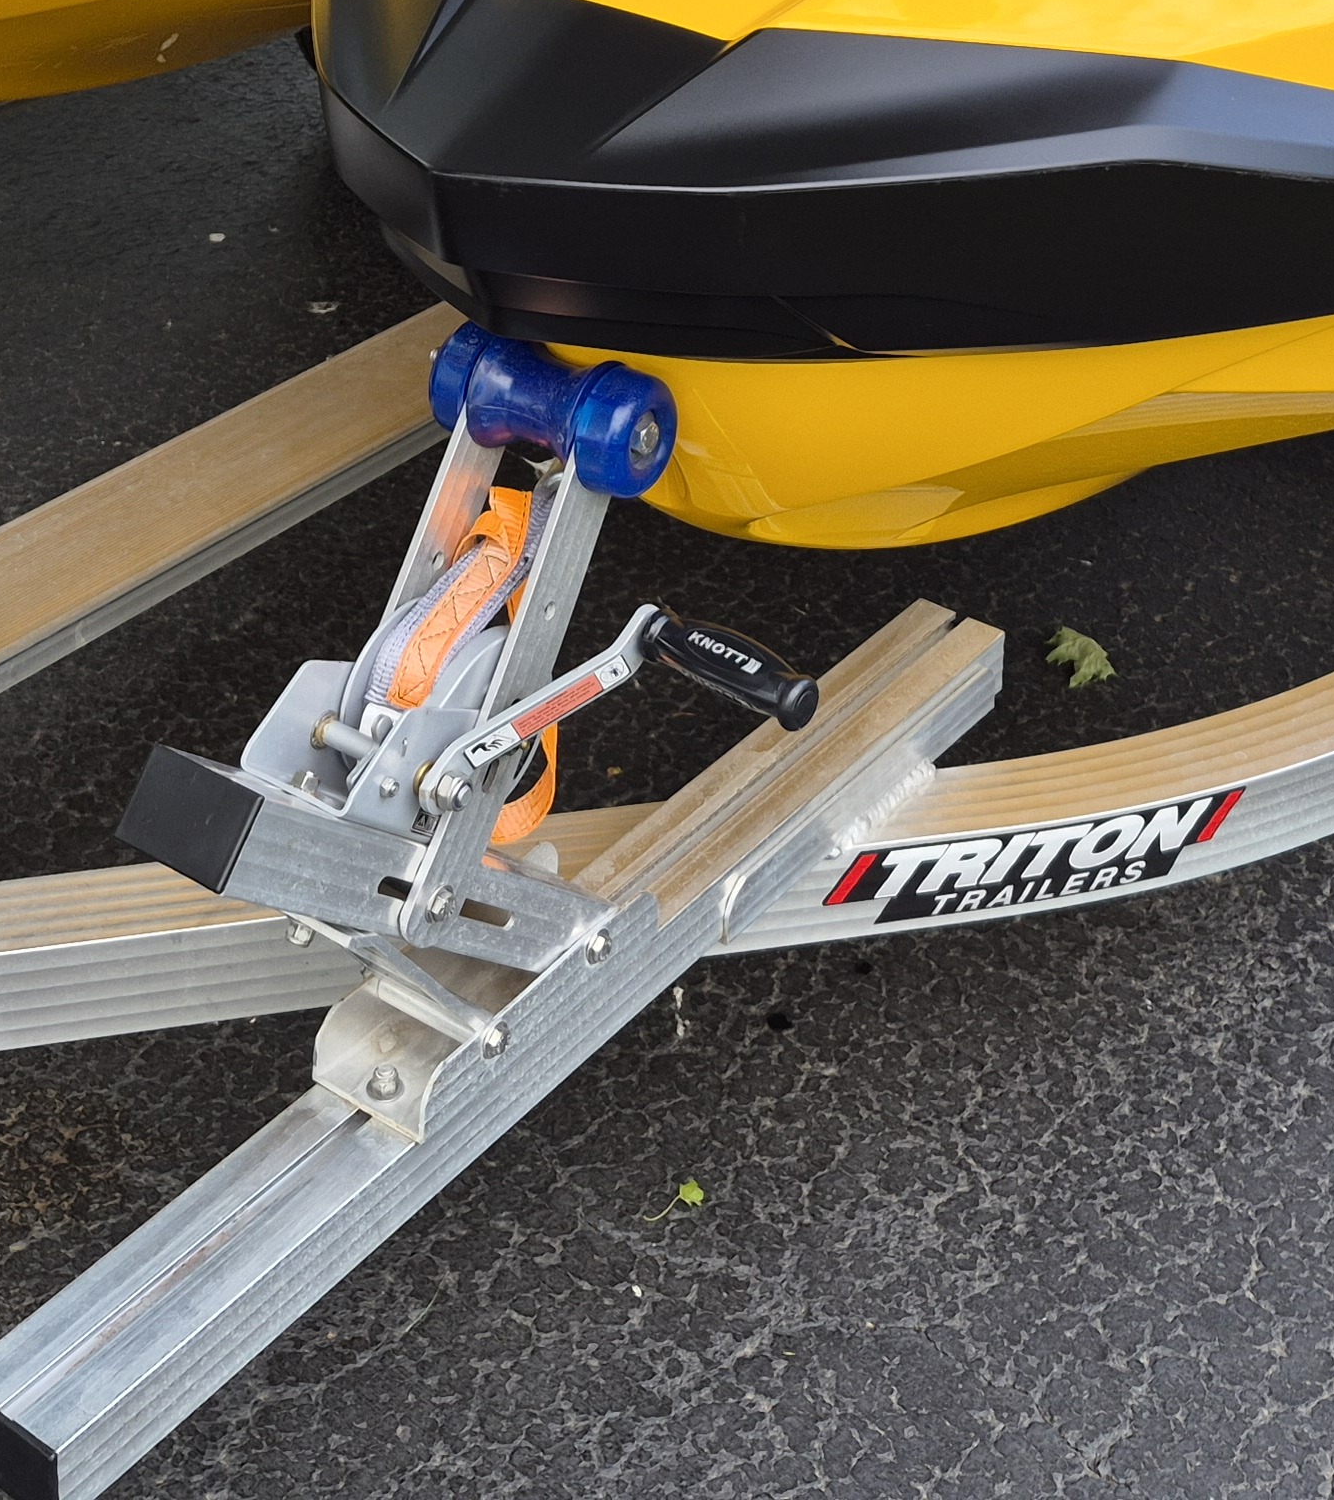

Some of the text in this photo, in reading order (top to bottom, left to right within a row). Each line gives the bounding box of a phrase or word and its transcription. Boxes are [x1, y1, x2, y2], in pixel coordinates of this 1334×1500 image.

[687, 630, 748, 666] KNOTT
[873, 796, 1214, 899] TRITON
[930, 860, 1147, 917] TRAILERS
